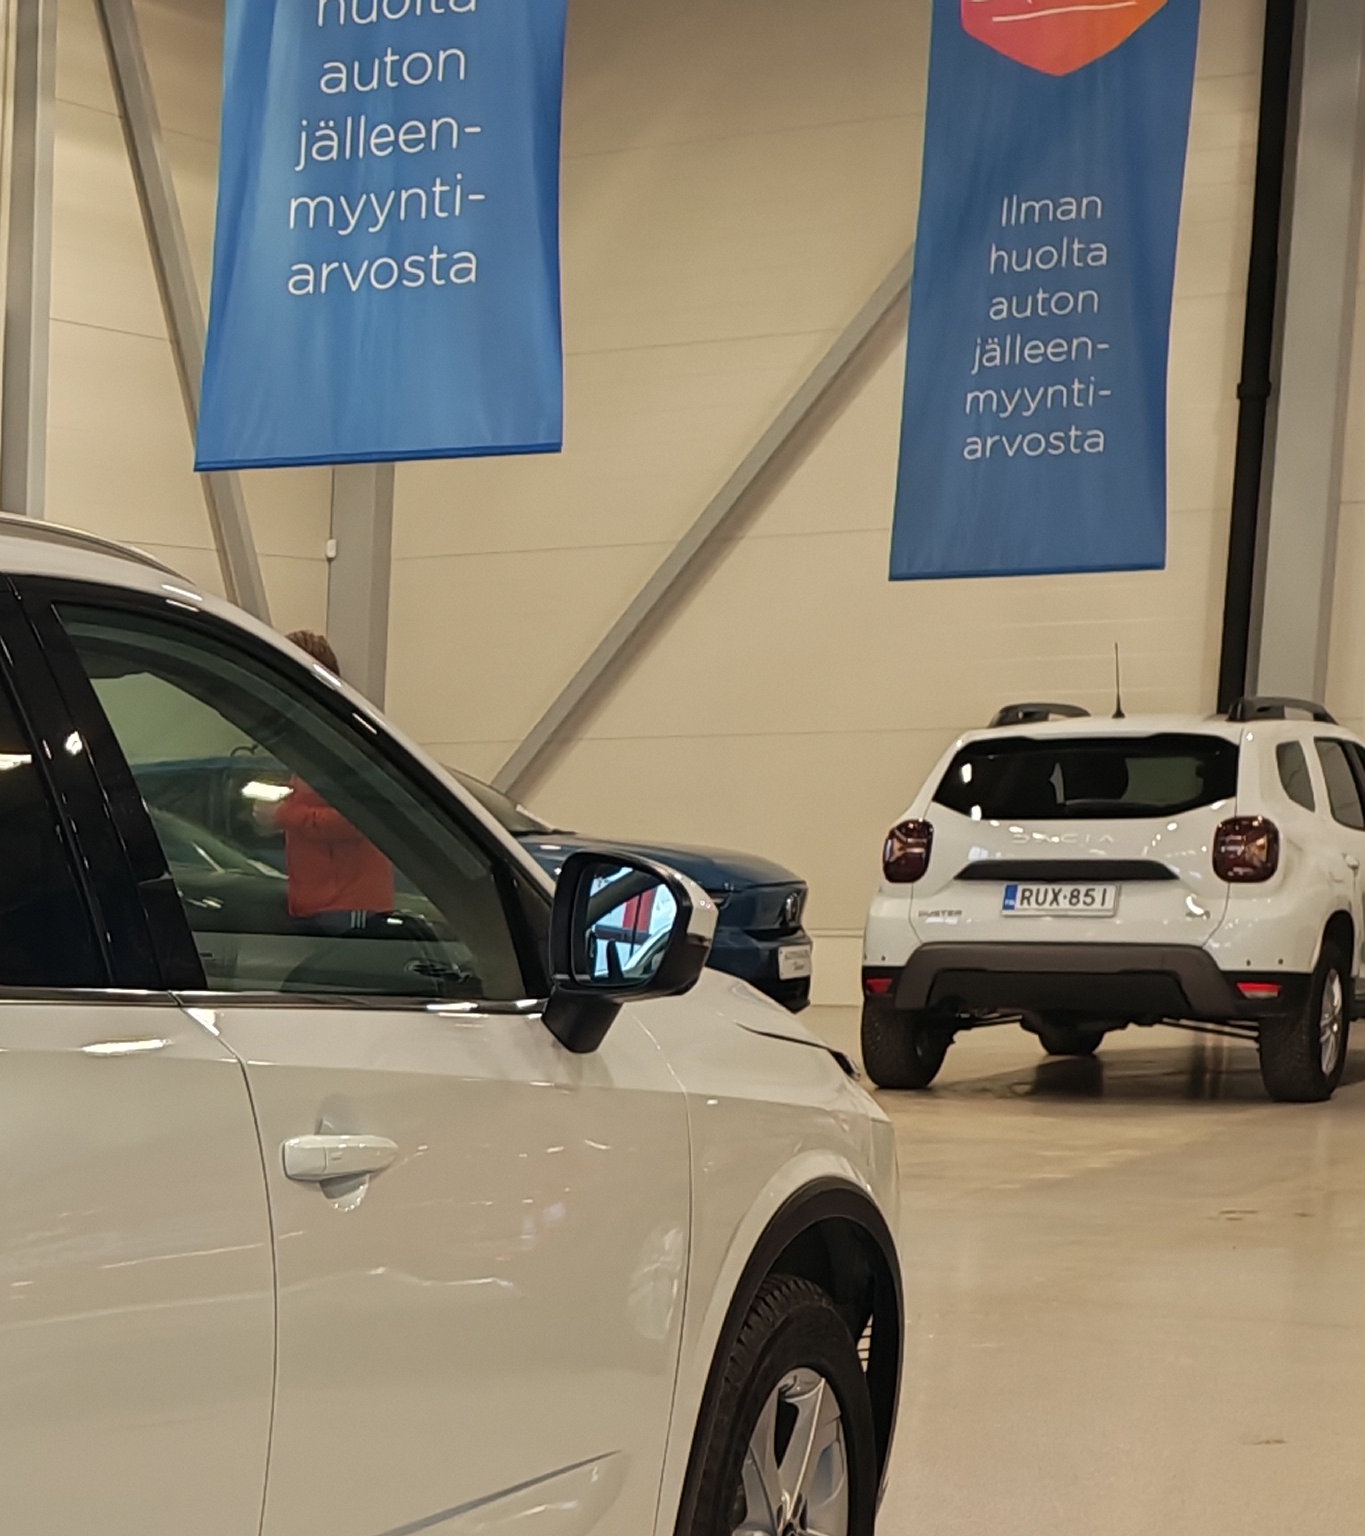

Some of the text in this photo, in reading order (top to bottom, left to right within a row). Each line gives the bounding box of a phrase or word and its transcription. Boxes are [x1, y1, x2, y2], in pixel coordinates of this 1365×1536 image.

[319, 47, 466, 94] auton
[294, 115, 481, 171] jälleen-
[289, 173, 485, 235] myynti-
[1001, 194, 1102, 227] Ilman
[287, 245, 478, 295] arvosta
[989, 236, 1108, 274] huolta
[989, 287, 1099, 320] auton
[971, 333, 1110, 375] jälleen-
[965, 376, 1112, 418] myynti-
[963, 425, 1105, 460] arvosta
